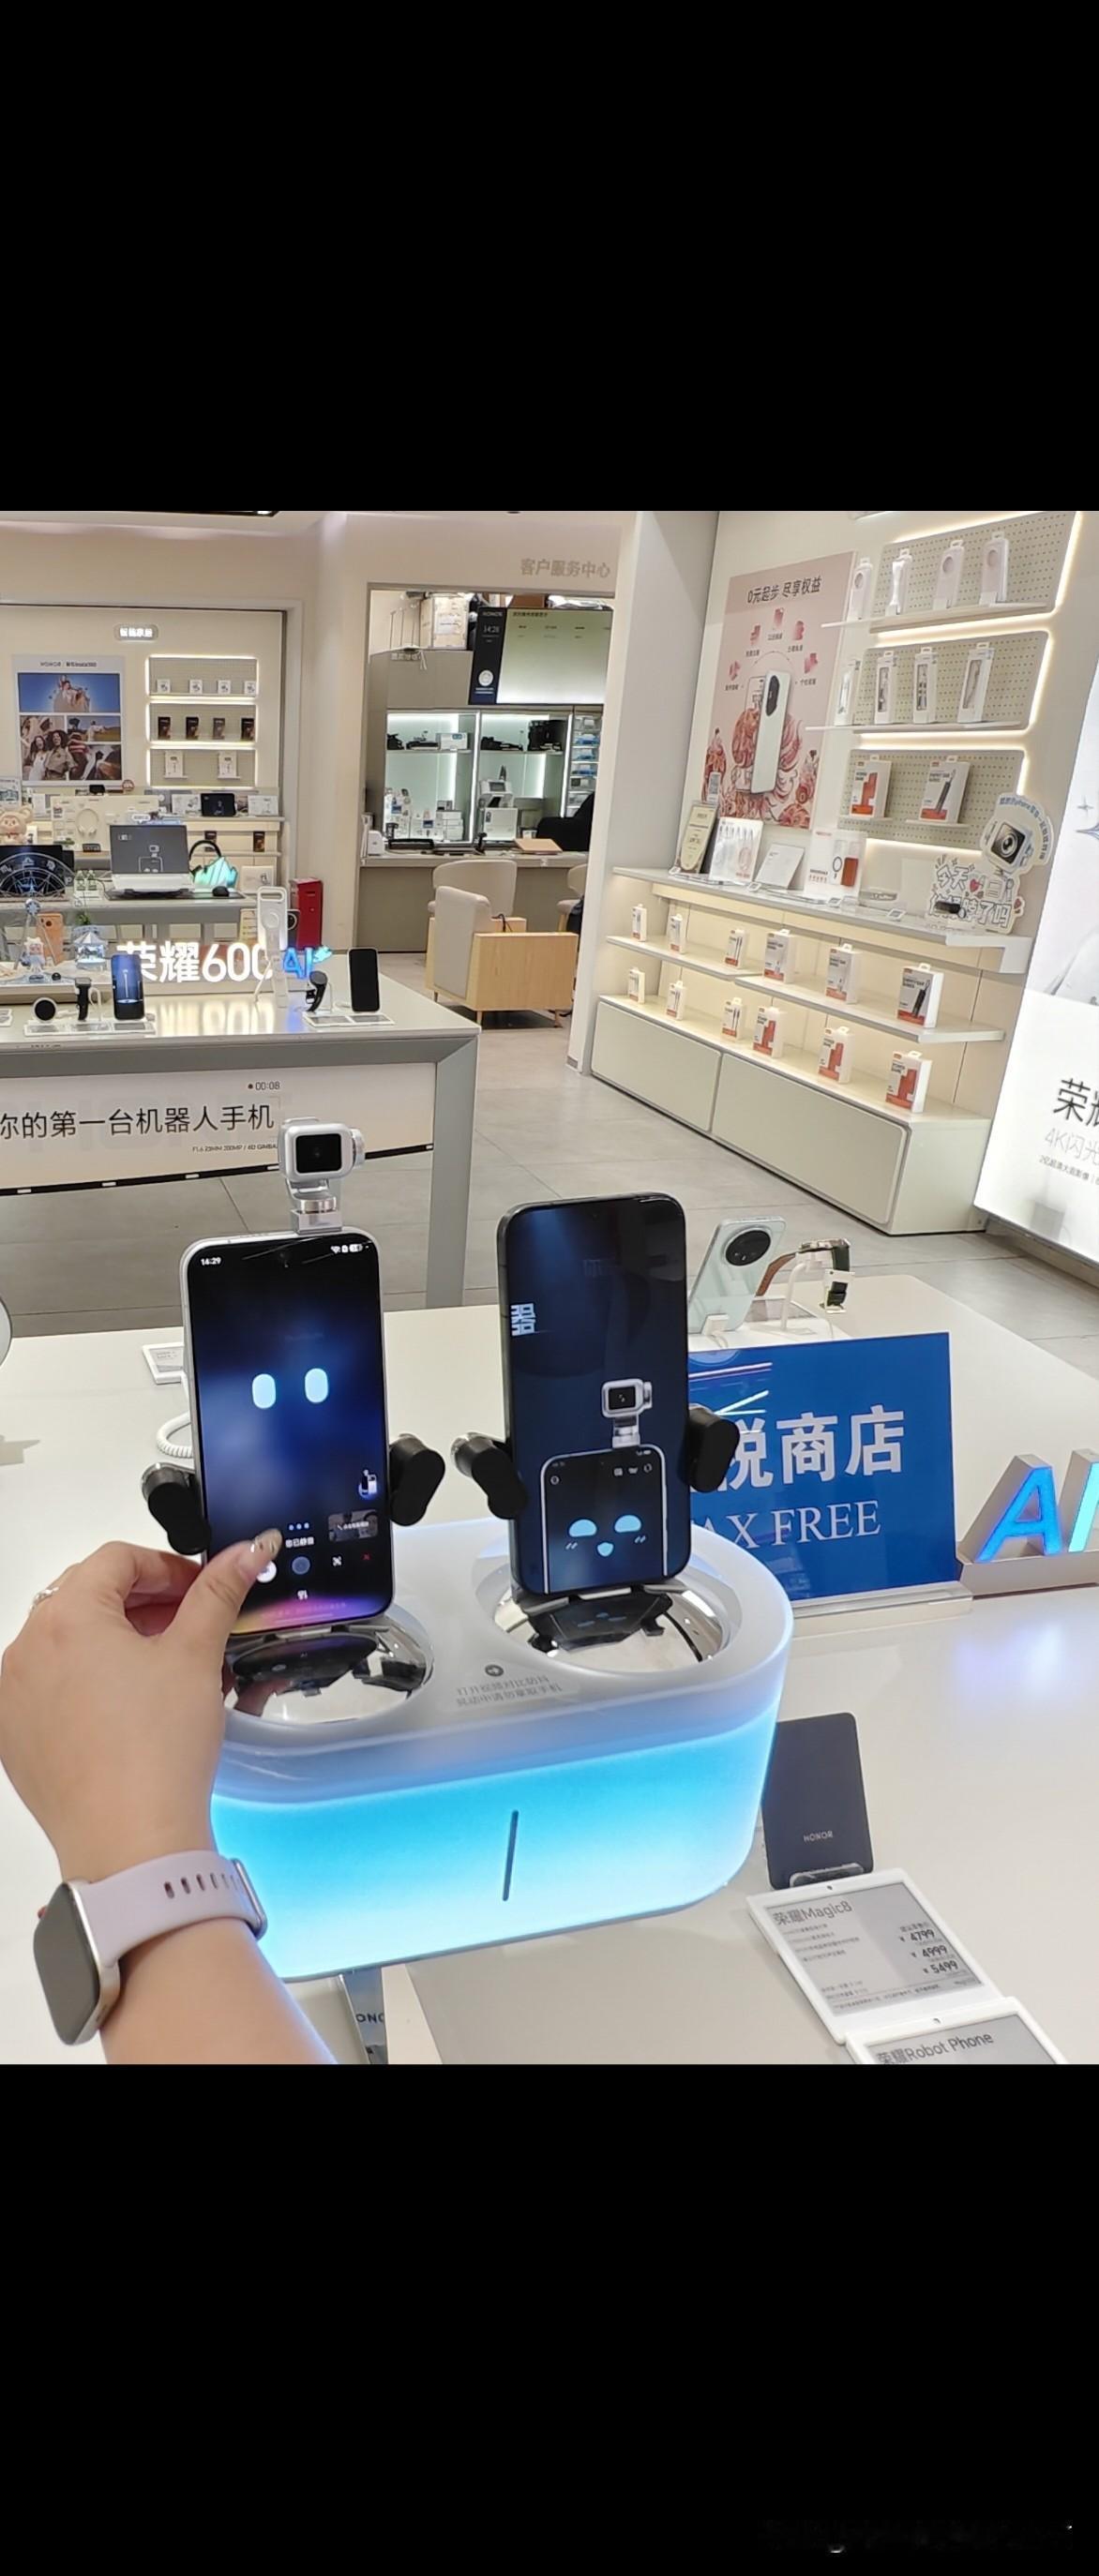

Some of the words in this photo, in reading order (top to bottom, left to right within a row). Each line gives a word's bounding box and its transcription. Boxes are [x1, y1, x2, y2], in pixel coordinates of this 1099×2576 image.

[520, 558, 610, 578] 客户服务中心
[747, 585, 780, 605] 0元起步
[782, 575, 822, 597] 尽享权益
[255, 1081, 280, 1091] 00:08
[0, 1103, 275, 1140] 你的第一台机器人手机
[690, 1404, 905, 1492] 税商店
[772, 1500, 881, 1546] FREE
[803, 1830, 833, 1842] HONOR
[773, 1900, 852, 1925] 荣耀Magic8
[910, 1929, 935, 1941] 4799
[922, 1945, 947, 1957] 4999
[930, 1960, 958, 1973] 5499
[947, 2032, 994, 2052] Phone
